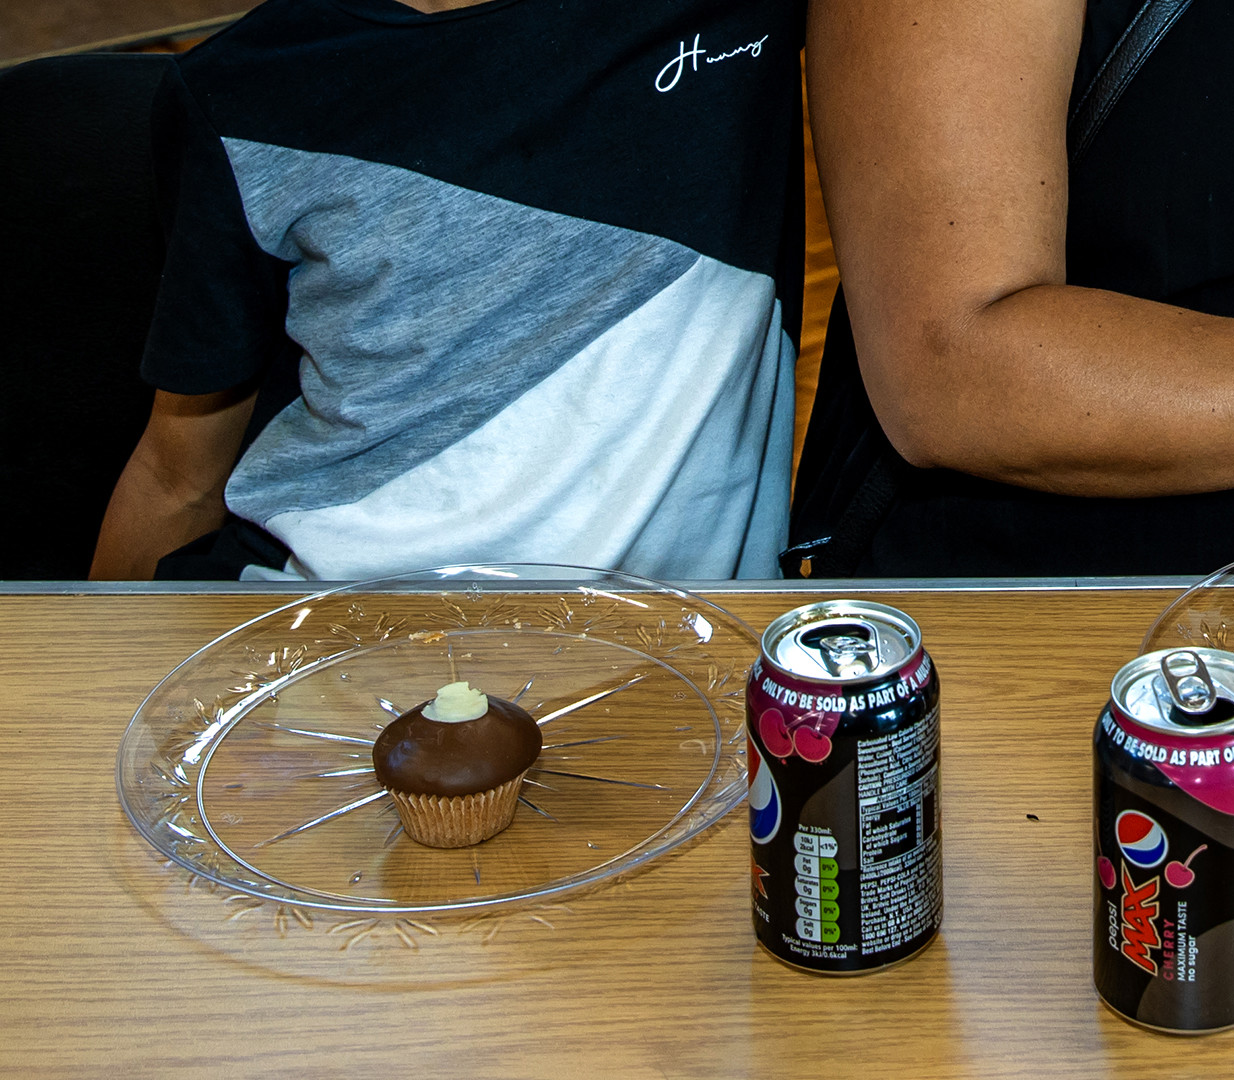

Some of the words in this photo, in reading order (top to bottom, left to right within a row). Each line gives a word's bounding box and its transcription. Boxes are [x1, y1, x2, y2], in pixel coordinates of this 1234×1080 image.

[762, 677, 785, 700] ONLY
[783, 688, 798, 706] TO
[799, 693, 814, 710] BE
[816, 696, 847, 713] SOLD
[849, 694, 866, 713] AS
[867, 686, 896, 710] PART
[896, 679, 910, 698] OF
[909, 676, 919, 691] A
[1112, 727, 1126, 745] TO
[1123, 735, 1139, 758] BE
[1137, 742, 1168, 763] SOLD
[1169, 749, 1187, 766] AS
[1189, 749, 1221, 766] PART
[1108, 899, 1120, 952] pepsi
[1121, 857, 1162, 977] MAX
[1177, 901, 1188, 931] TASTE
[789, 944, 810, 957] Energy
[822, 944, 834, 952] per
[1163, 918, 1176, 981] CHERRY
[1177, 931, 1187, 981] MAXIMUM
[1188, 935, 1199, 967] sugar
[1188, 967, 1196, 982] no
